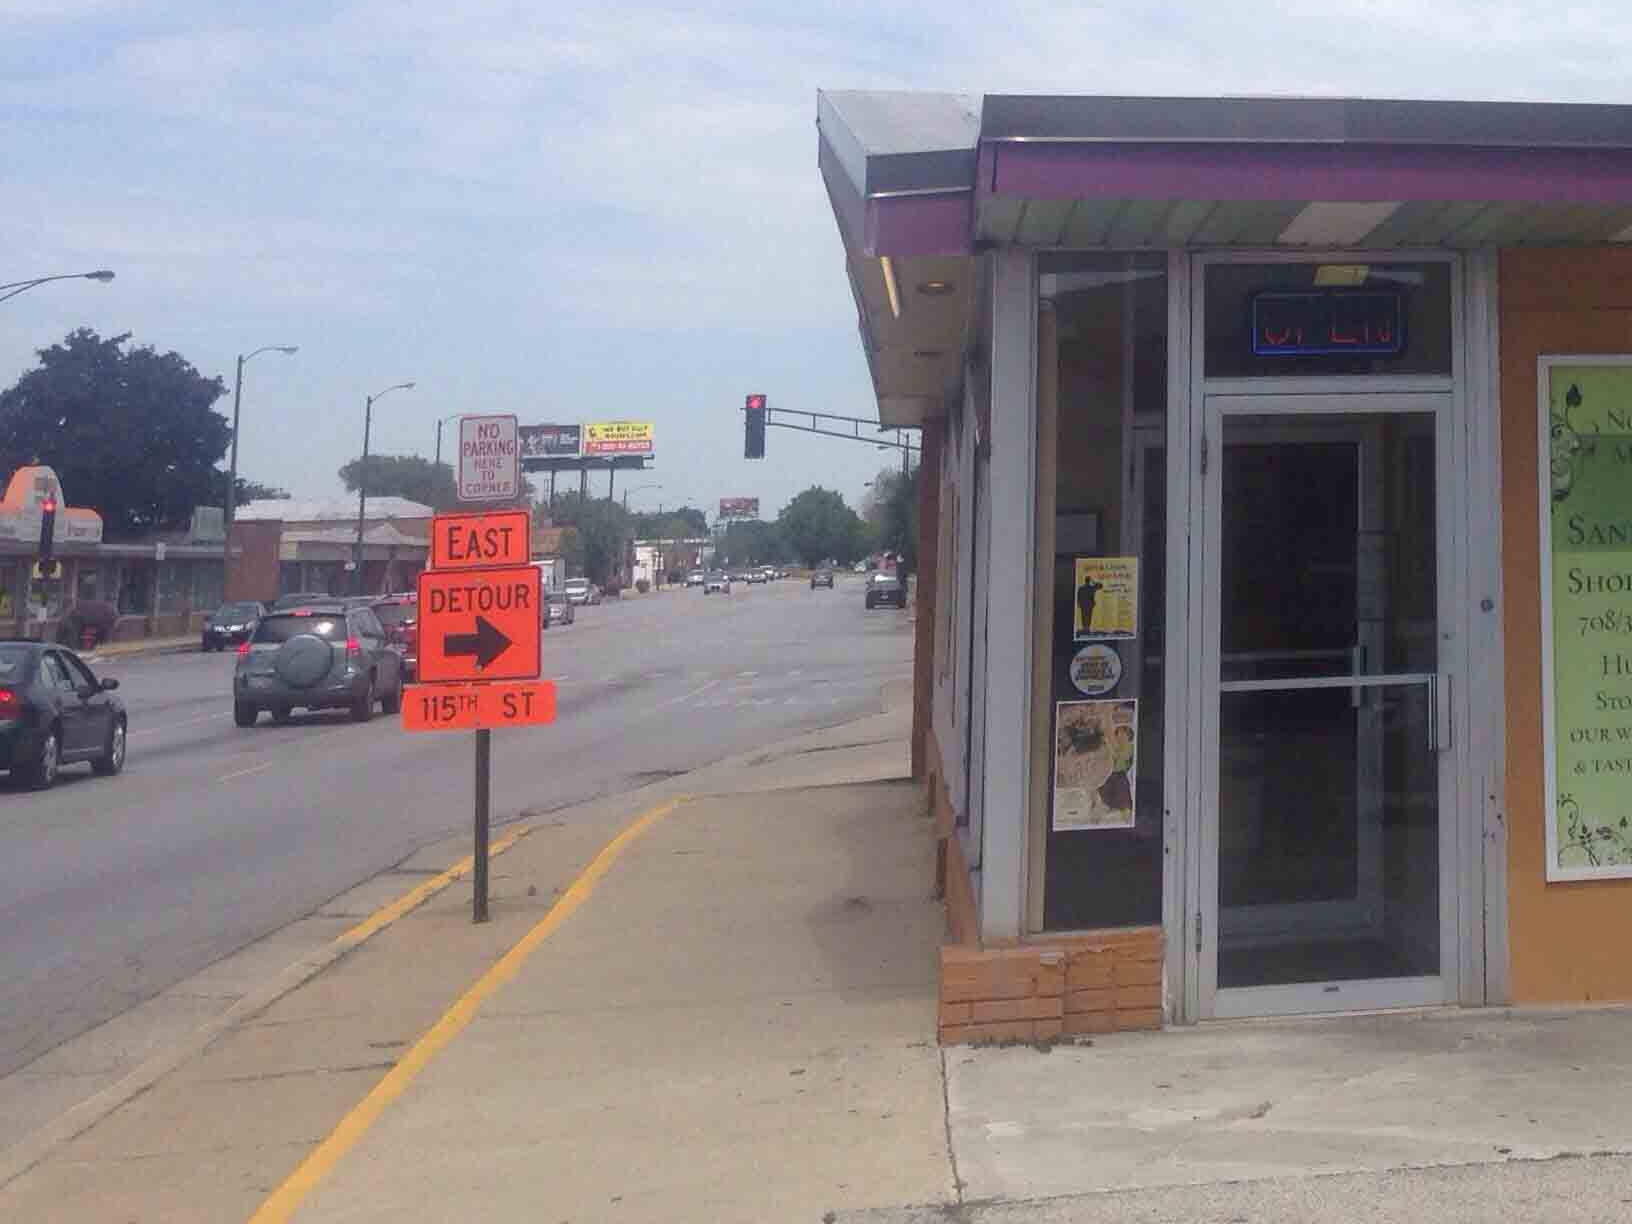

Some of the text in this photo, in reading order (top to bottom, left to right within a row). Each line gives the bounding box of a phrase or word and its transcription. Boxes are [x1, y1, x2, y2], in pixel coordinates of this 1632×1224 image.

[478, 423, 500, 440] NO
[463, 439, 514, 457] PARKING
[481, 470, 495, 481] TO
[447, 525, 513, 561] EAST
[429, 584, 530, 614] DETOUR
[422, 691, 536, 722] 115TH ST
[1569, 726, 1613, 745] OUR
